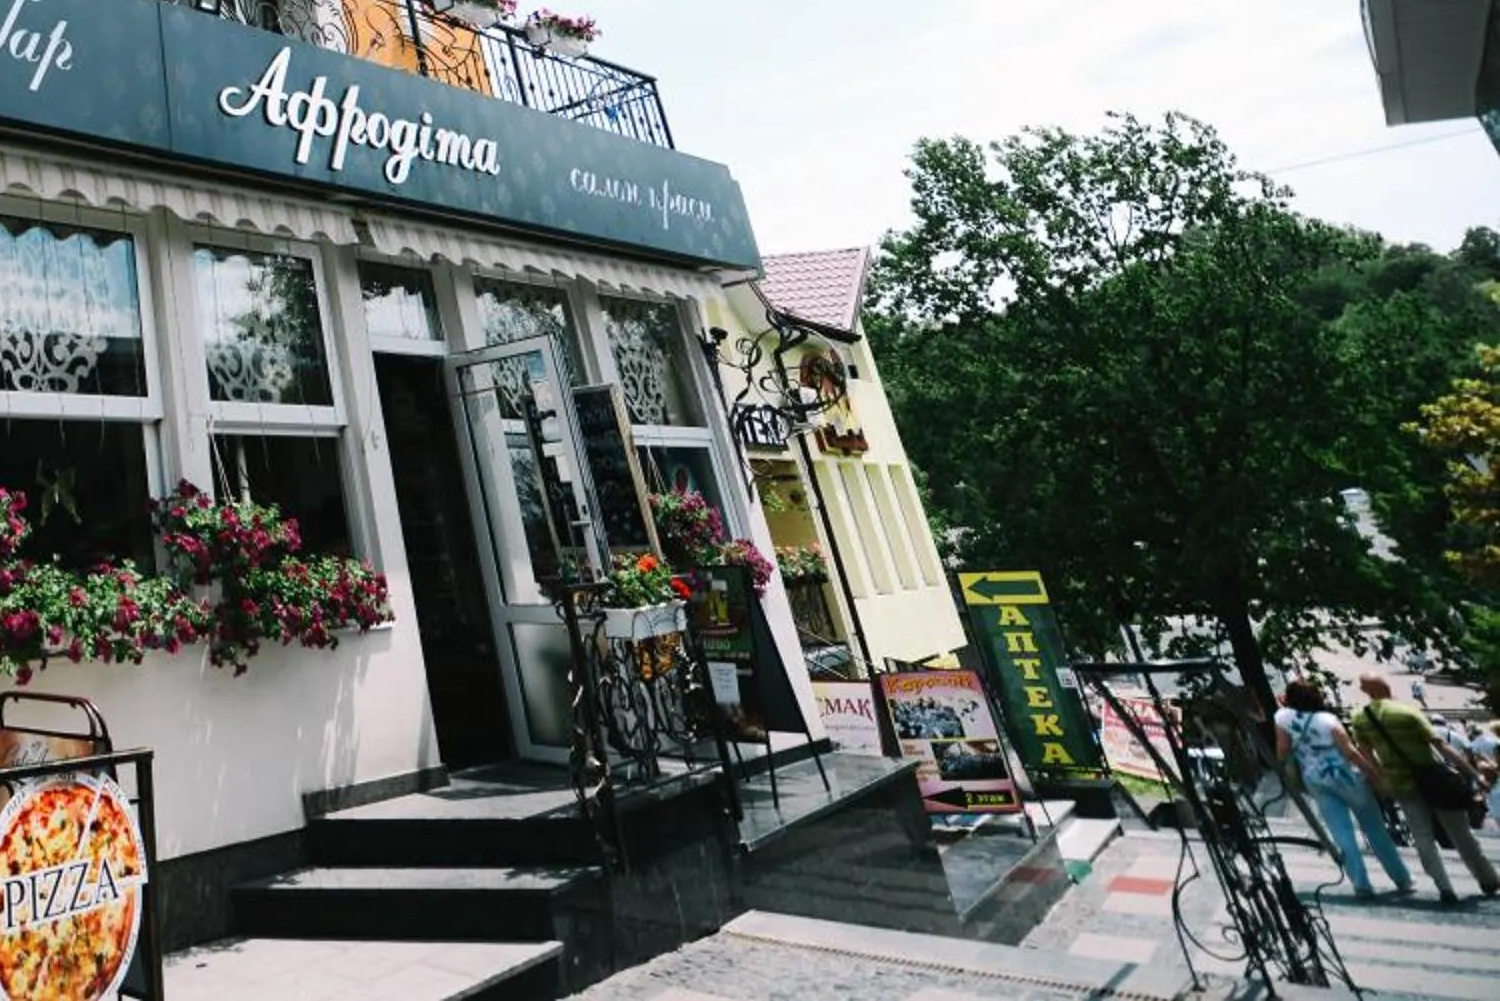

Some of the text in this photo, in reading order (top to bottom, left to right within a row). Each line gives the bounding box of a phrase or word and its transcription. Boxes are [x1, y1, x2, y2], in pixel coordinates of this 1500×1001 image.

[219, 46, 500, 183] Афродіта
[998, 605, 1076, 765] АПТЕКА
[4, 859, 120, 929] PIZZA
